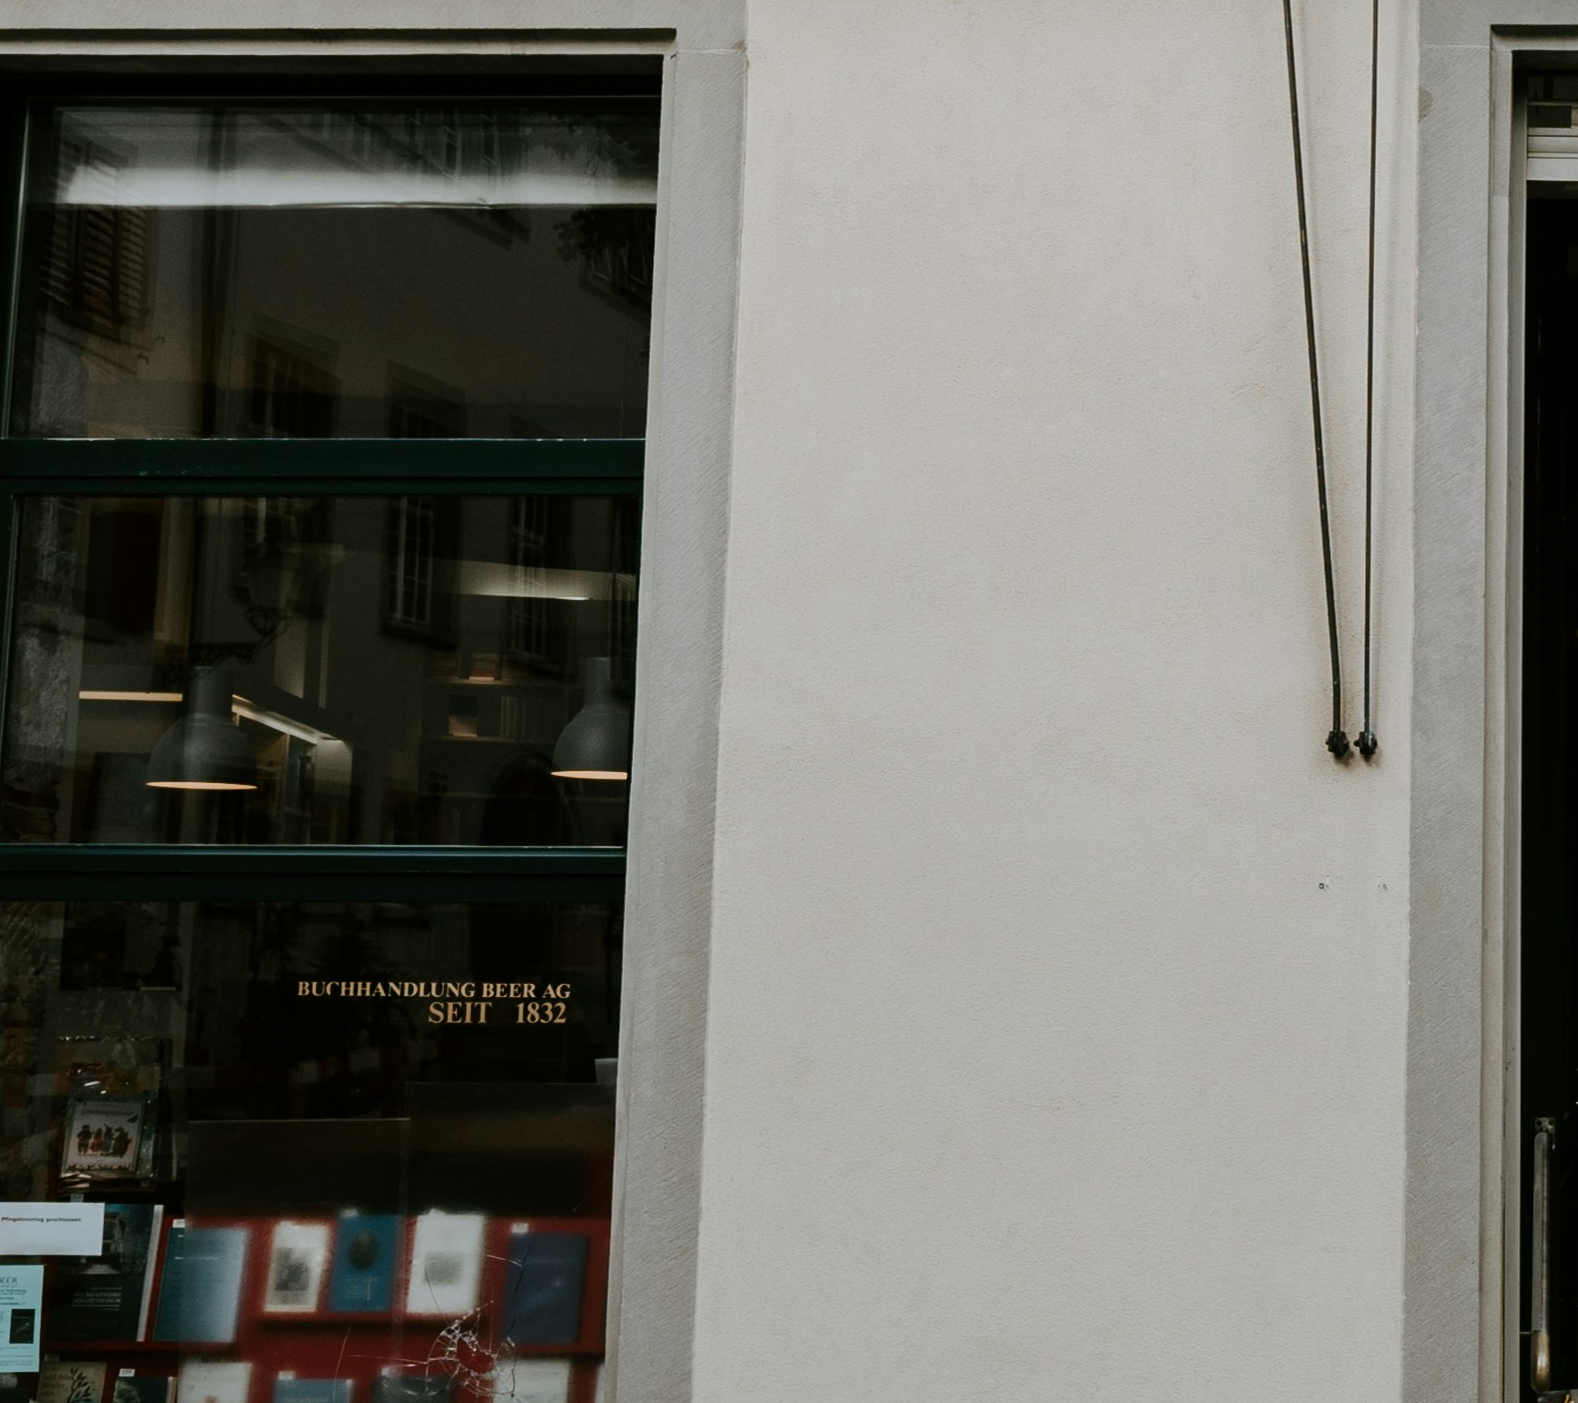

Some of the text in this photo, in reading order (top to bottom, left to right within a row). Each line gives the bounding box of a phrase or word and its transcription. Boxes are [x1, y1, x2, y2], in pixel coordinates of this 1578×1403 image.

[297, 981, 571, 998] BUCHHANDLUNG BEER AG
[428, 1001, 567, 1024] SEIT 1832
